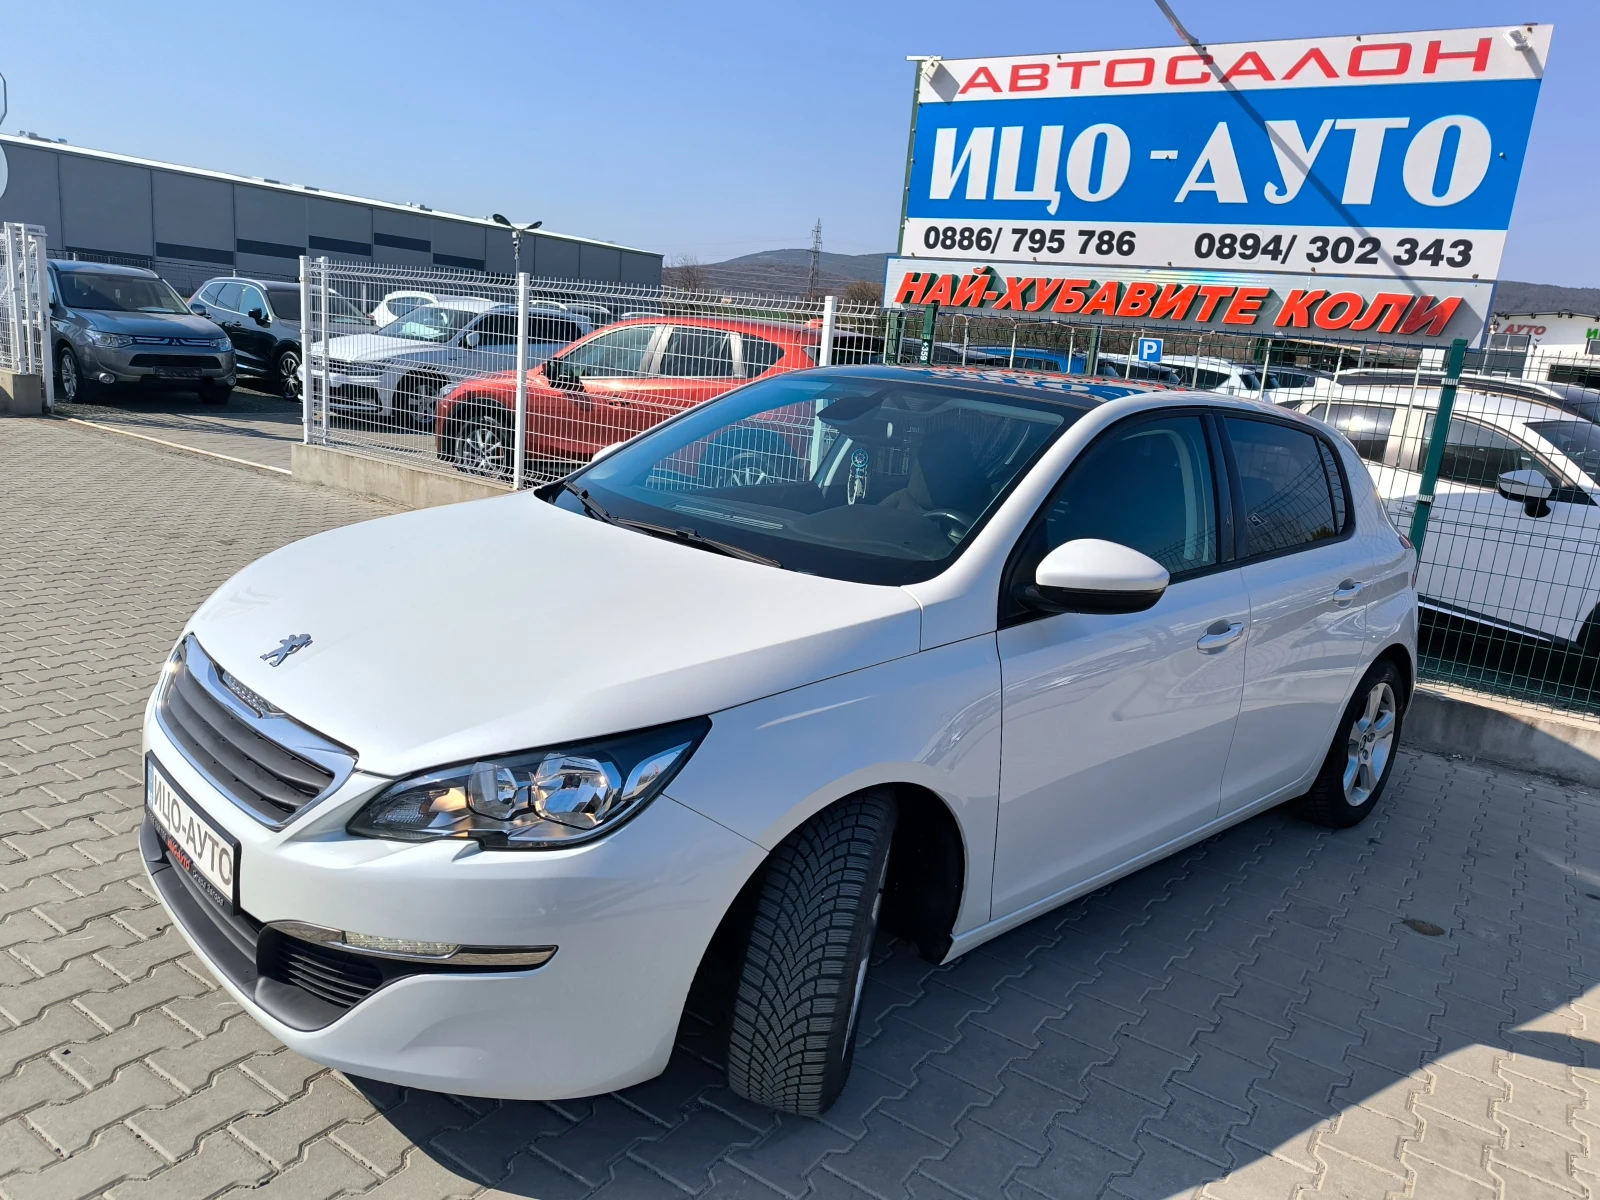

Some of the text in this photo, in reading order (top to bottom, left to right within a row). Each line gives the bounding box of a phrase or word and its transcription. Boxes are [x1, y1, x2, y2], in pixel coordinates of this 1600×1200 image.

[959, 38, 1493, 95] АВТОСАЛОН
[923, 226, 1137, 257] 0886/ 795 786
[1194, 232, 1474, 268] 0894/ 302 343
[894, 266, 1463, 336] НАЙ-ХУБАВИТЕ КОЛИ
[1503, 323, 1547, 336] АУТО
[920, 341, 929, 361] +359
[1142, 341, 1158, 360] P
[154, 774, 233, 886] ИЦО-АУТО
